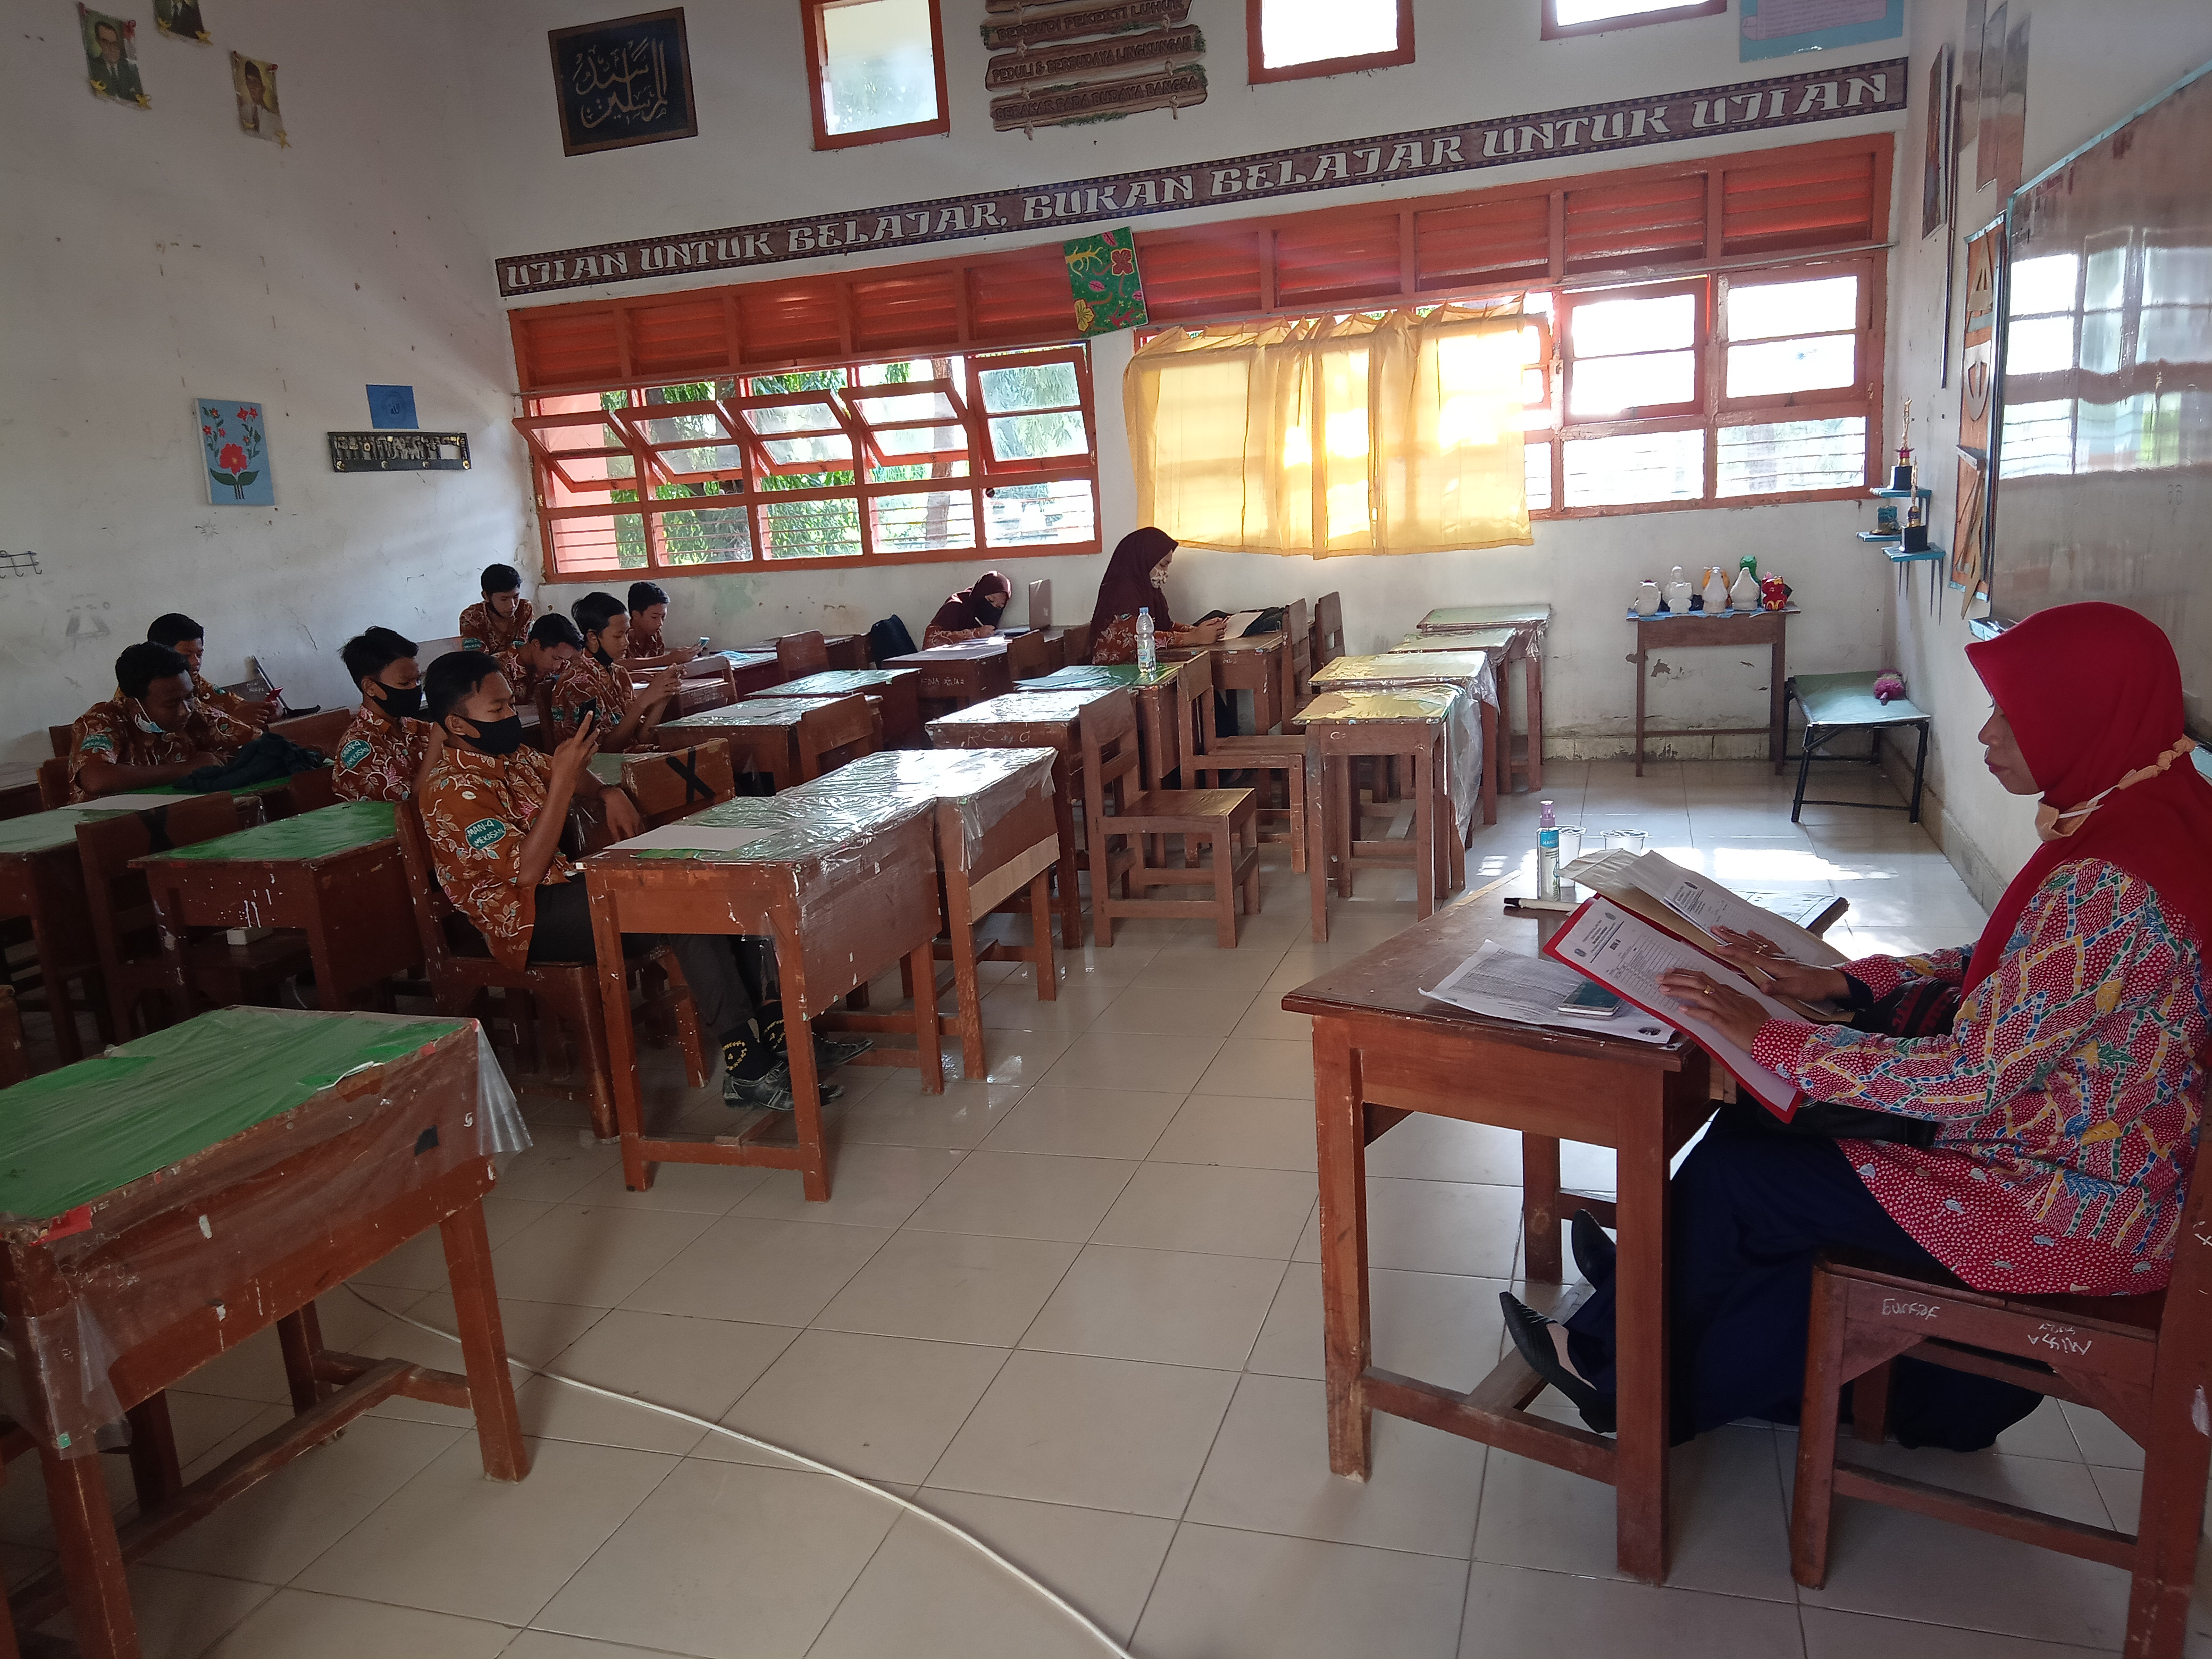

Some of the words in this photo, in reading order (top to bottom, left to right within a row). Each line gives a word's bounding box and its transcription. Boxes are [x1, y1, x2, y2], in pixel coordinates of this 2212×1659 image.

[996, 18, 1061, 41] BERBUDI
[1064, 6, 1128, 29] PEKERTI
[1131, 0, 1185, 16] LUHUR
[992, 63, 1034, 83] PEDULI
[1036, 61, 1045, 75] &
[1046, 49, 1116, 73] BERBUDAYA
[1117, 35, 1192, 60] LINGKUNGAN
[995, 99, 1054, 121] BERAKAR
[1056, 94, 1090, 112] PADA
[1092, 85, 1144, 106] BUDAYA
[1145, 76, 1196, 97] BANGSA
[506, 252, 627, 289] UJIAN
[639, 232, 774, 271] UNTUK
[1023, 174, 1194, 222] BUKAN
[1210, 135, 1465, 197] BELAJAR
[1482, 106, 1671, 158] UNTUK
[1690, 73, 1888, 128] UJIAN
[468, 819, 495, 839] MAN-4
